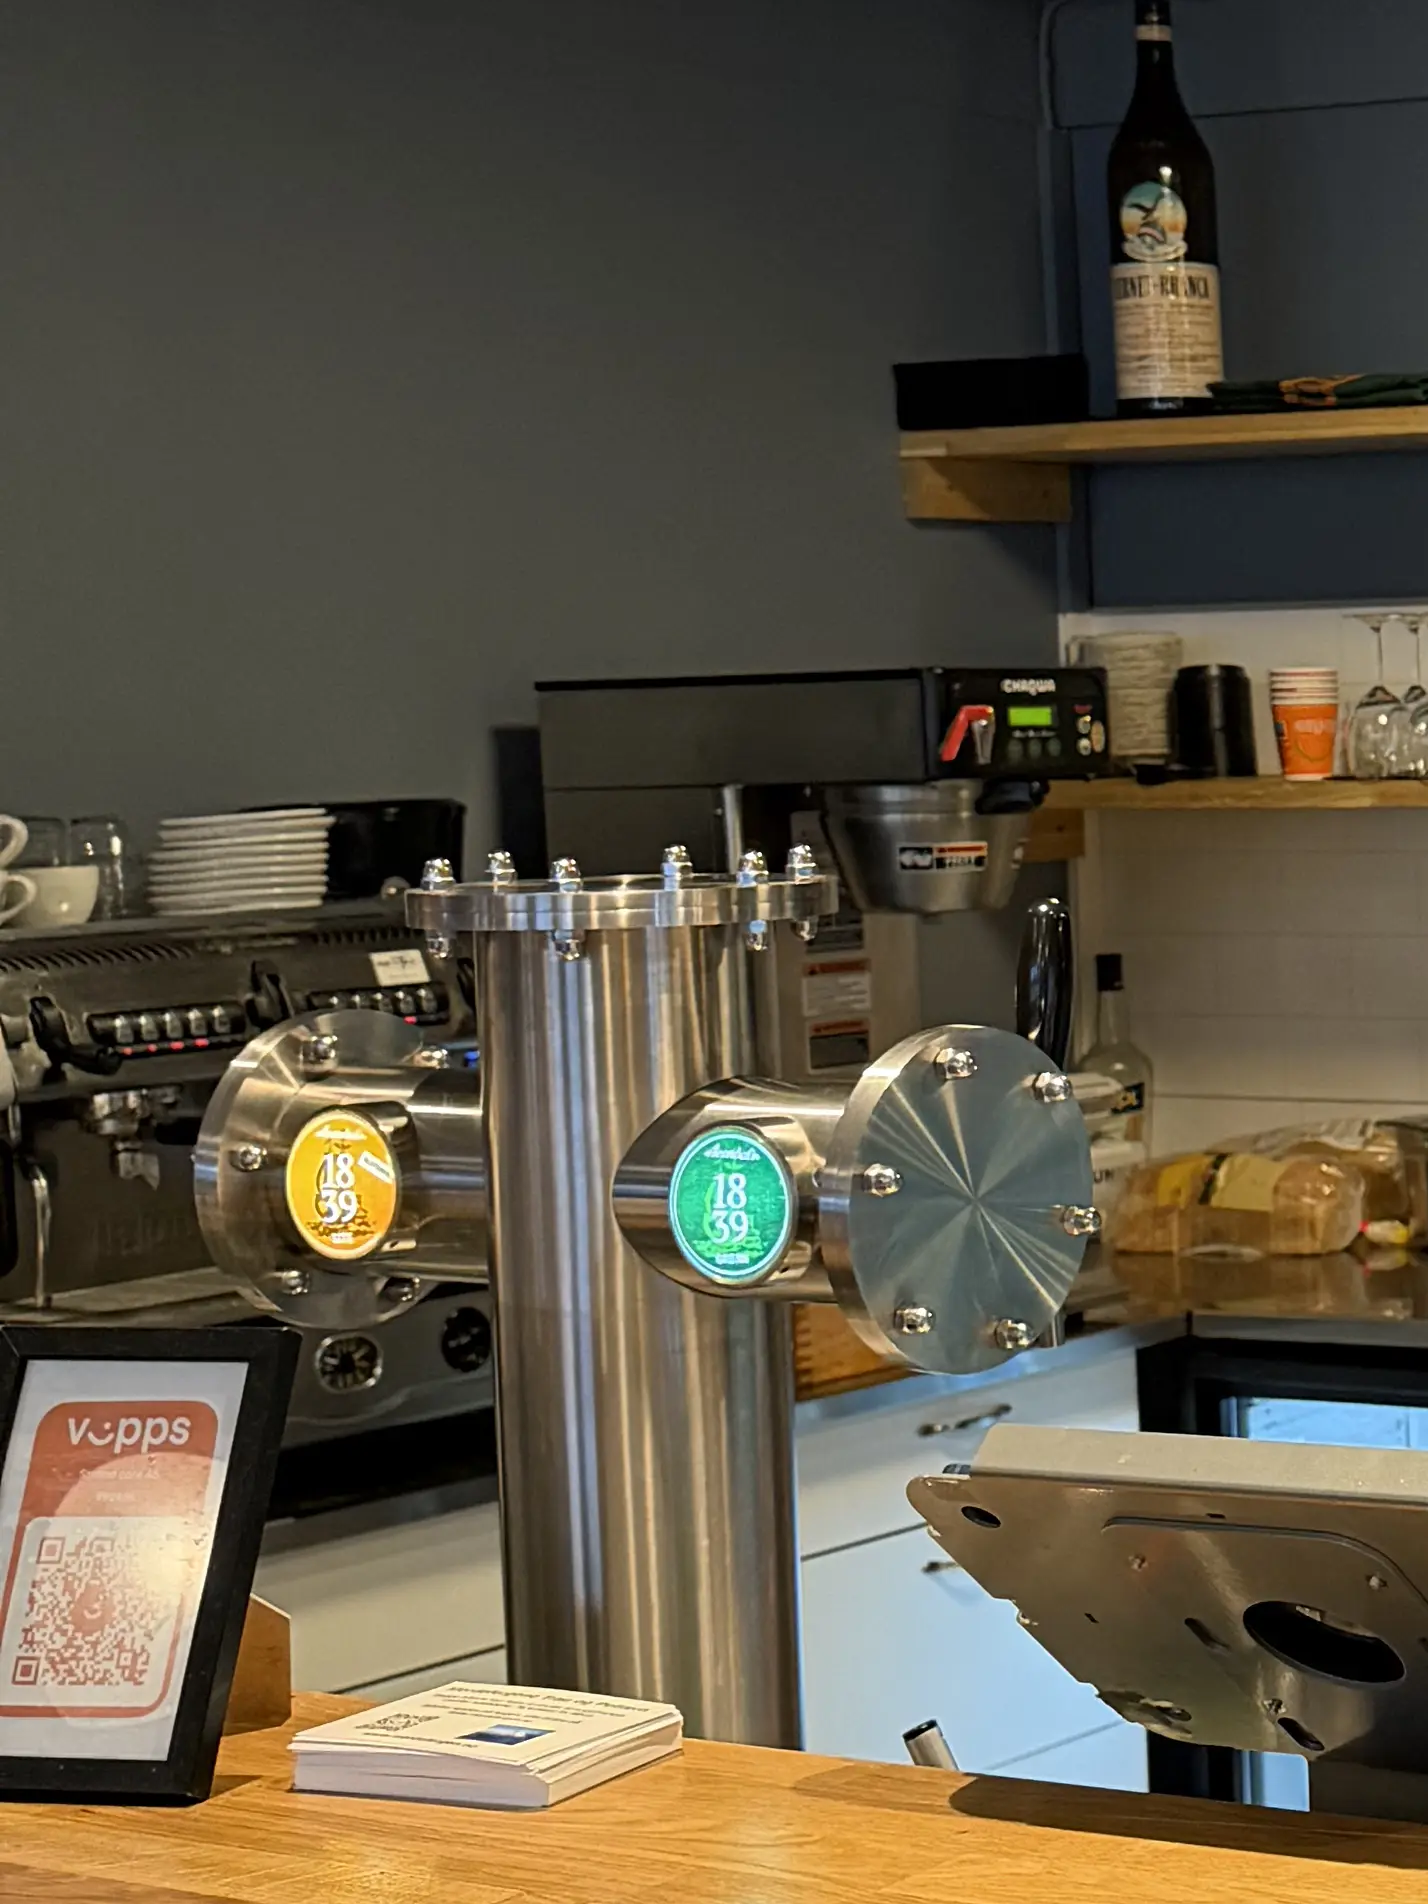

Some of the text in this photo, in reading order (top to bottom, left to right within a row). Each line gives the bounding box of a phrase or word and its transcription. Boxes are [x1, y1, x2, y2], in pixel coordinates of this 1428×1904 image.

[1001, 682, 1056, 696] CHAQWA
[321, 1152, 356, 1189] 18
[320, 1189, 358, 1224] 39
[713, 1172, 748, 1209] 18
[711, 1209, 749, 1245] 39
[68, 1416, 192, 1455] vipps
